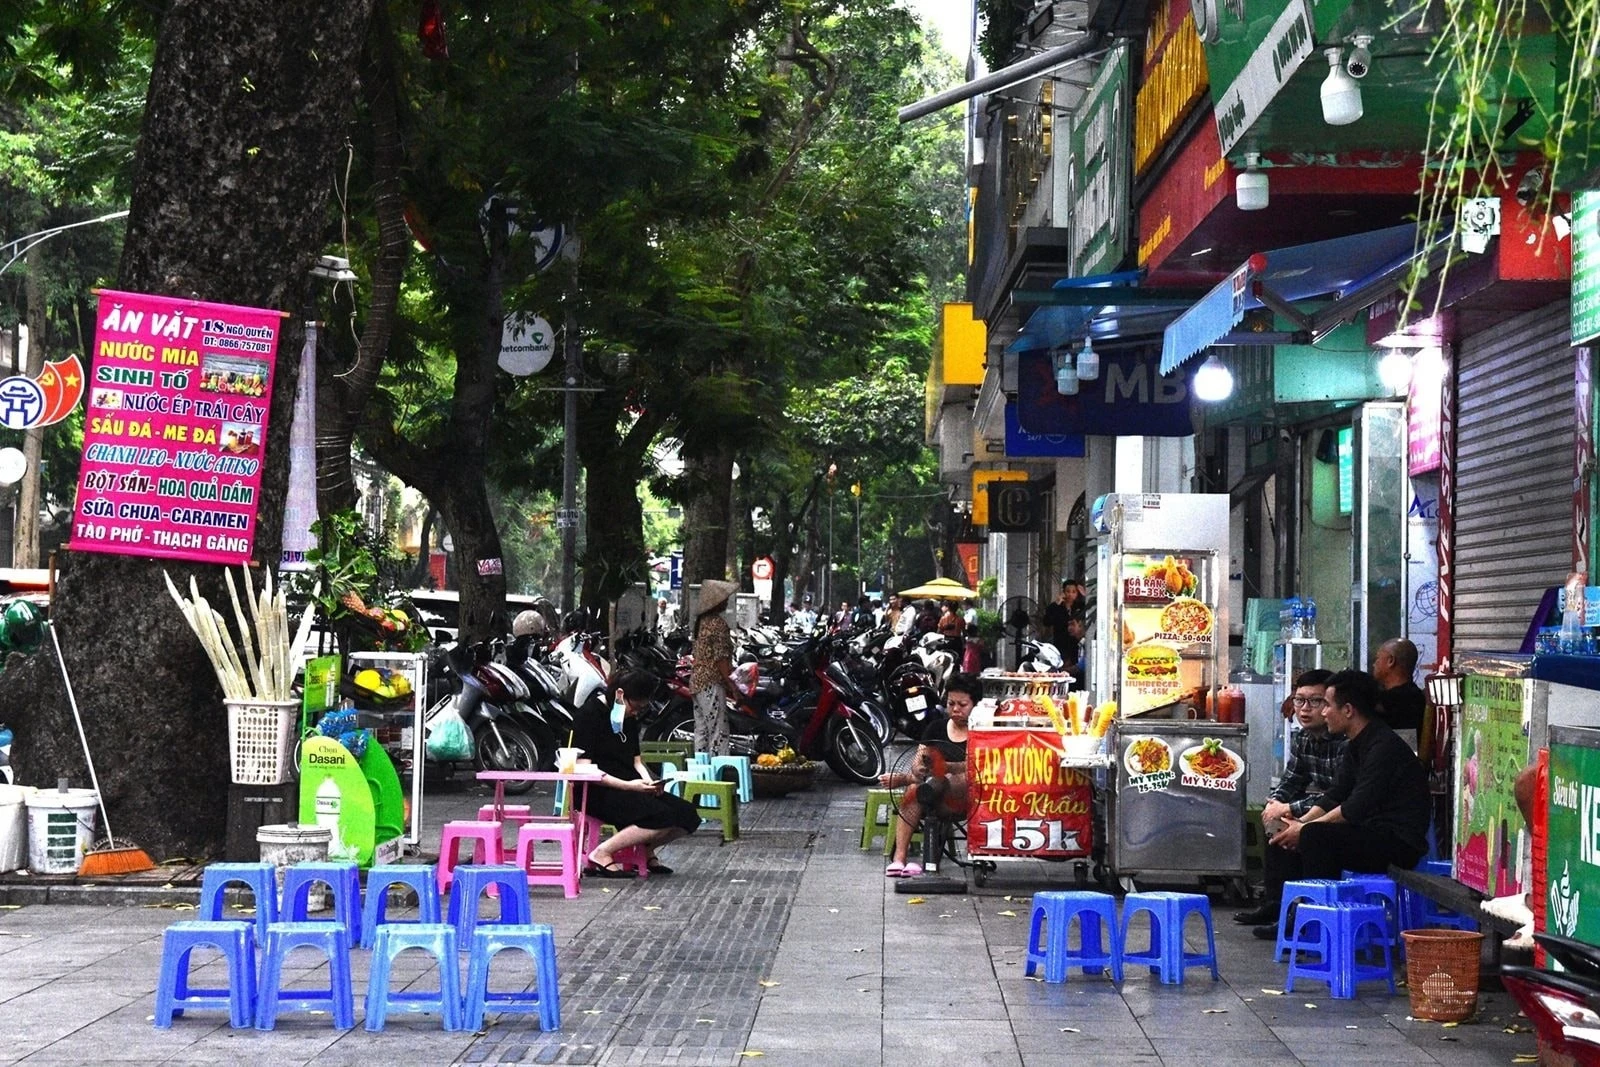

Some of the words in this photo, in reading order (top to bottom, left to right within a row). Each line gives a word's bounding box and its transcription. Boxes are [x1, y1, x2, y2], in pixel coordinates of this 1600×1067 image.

[102, 303, 144, 333] ĂN
[151, 310, 199, 342] VẶT
[203, 320, 225, 333] 18
[226, 324, 243, 336] NGÔ
[100, 340, 154, 361] NƯỚC
[161, 346, 199, 366] MÍA
[204, 337, 217, 346] ĐT:
[98, 367, 153, 385] SINH
[162, 369, 191, 389] TỐ
[1105, 363, 1188, 404] MB
[124, 393, 167, 412] NƯỚC
[172, 395, 191, 415] ÉP
[196, 399, 228, 419] TRÁI
[233, 403, 265, 423] CÂY
[91, 413, 123, 435] SẤU
[128, 418, 152, 438] ĐÁ
[163, 425, 188, 441] ME
[192, 425, 216, 445] ĐÁ
[87, 444, 138, 464] CHANH
[174, 450, 215, 471] NƯỚC
[214, 456, 258, 475] ATISO
[1442, 386, 1452, 514] STAR
[86, 472, 116, 493] BỘT
[158, 479, 185, 497] HOA
[190, 478, 217, 500] QUẢ
[83, 497, 114, 517] SỮA
[120, 504, 160, 521] CHUA
[171, 509, 248, 529] CARAMEN
[77, 522, 105, 539] TÀO
[110, 525, 143, 543] PHỚ
[153, 530, 202, 550] THẠCH
[206, 533, 248, 553] GĂNG
[1440, 519, 1449, 622] FIVE
[1154, 632, 1181, 641] PIZZA:
[1183, 632, 1212, 642] 50-60K
[309, 753, 345, 764] Dasani
[975, 747, 1001, 790] LẠP
[1004, 734, 1053, 785] XƯỞNG
[1214, 780, 1235, 790] 50K
[975, 788, 1020, 814] Hà
[979, 818, 1085, 851] 15k
